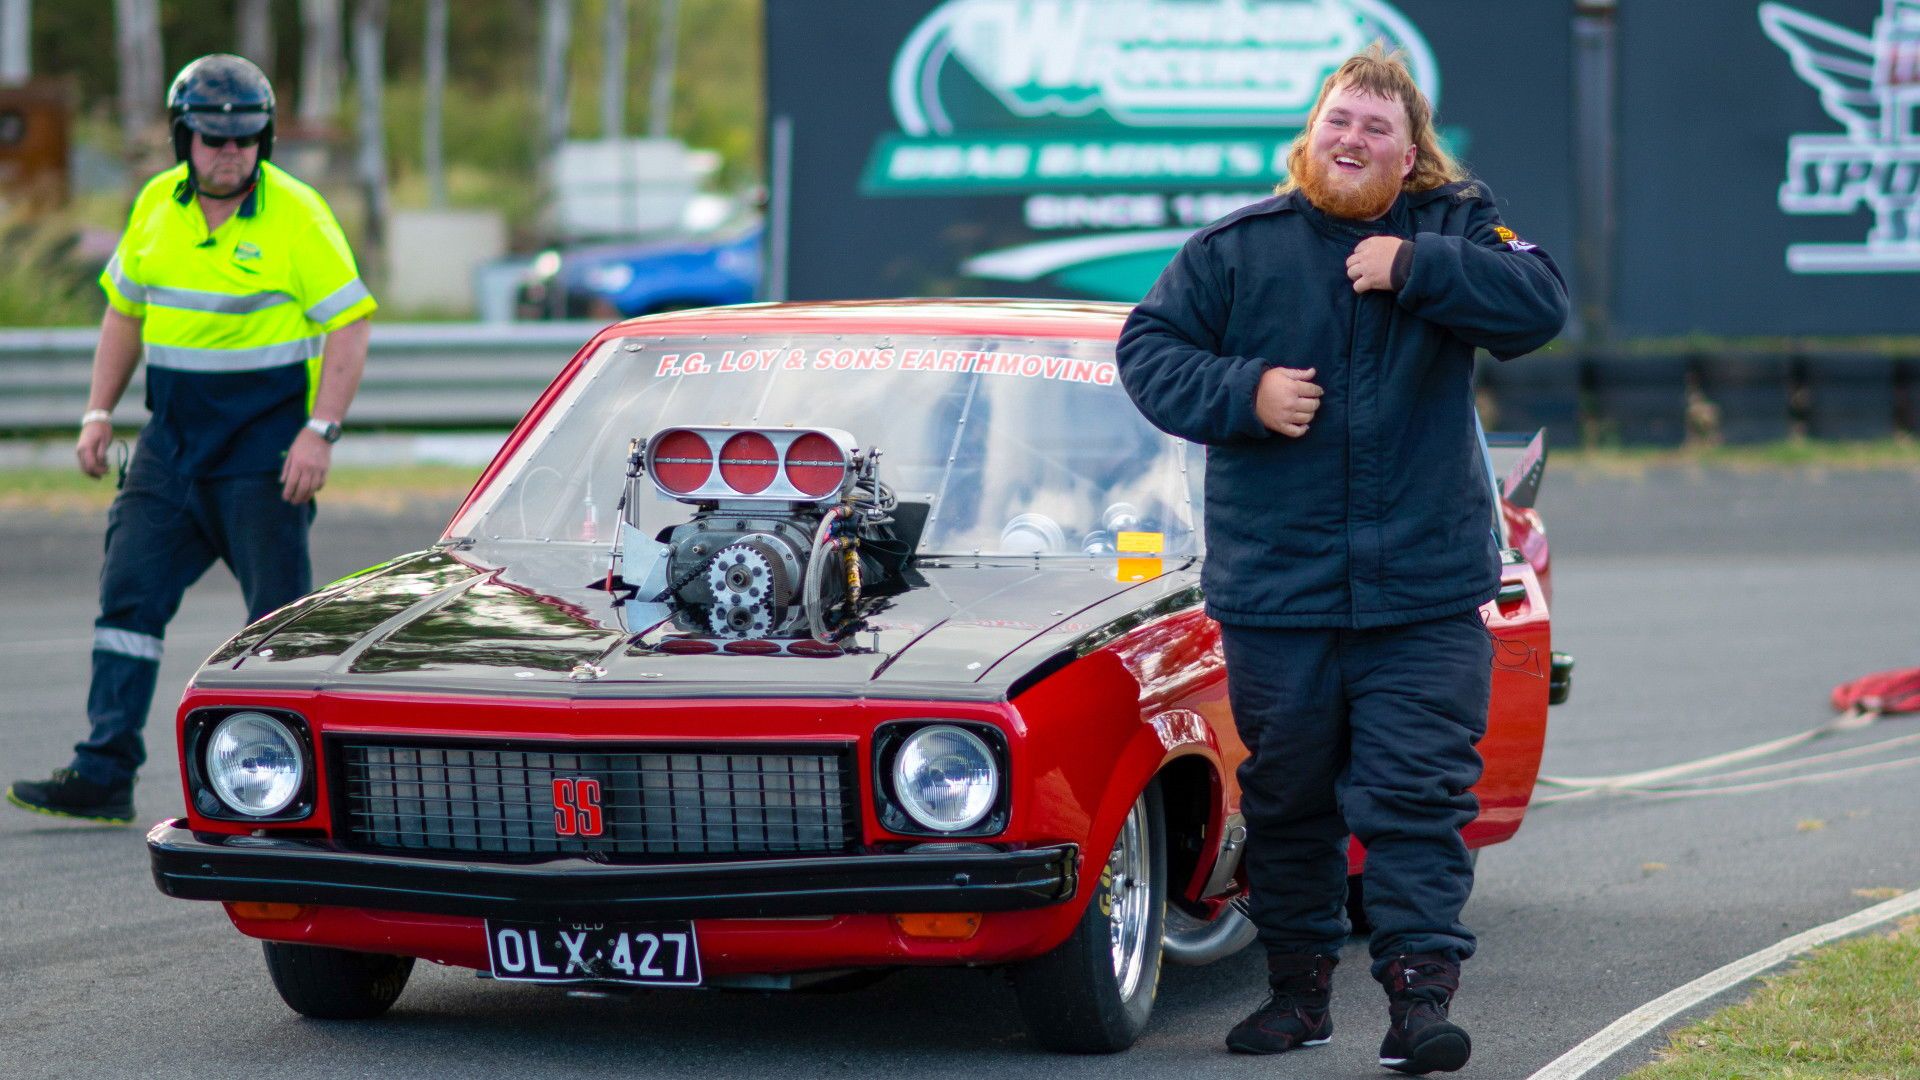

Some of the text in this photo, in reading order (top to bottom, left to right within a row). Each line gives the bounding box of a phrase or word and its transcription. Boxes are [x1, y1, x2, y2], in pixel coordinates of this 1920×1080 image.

[655, 347, 1117, 386] F.G. LOY & SONS EARTHMOVING
[552, 778, 603, 836] SS
[497, 928, 687, 976] OLX 427
